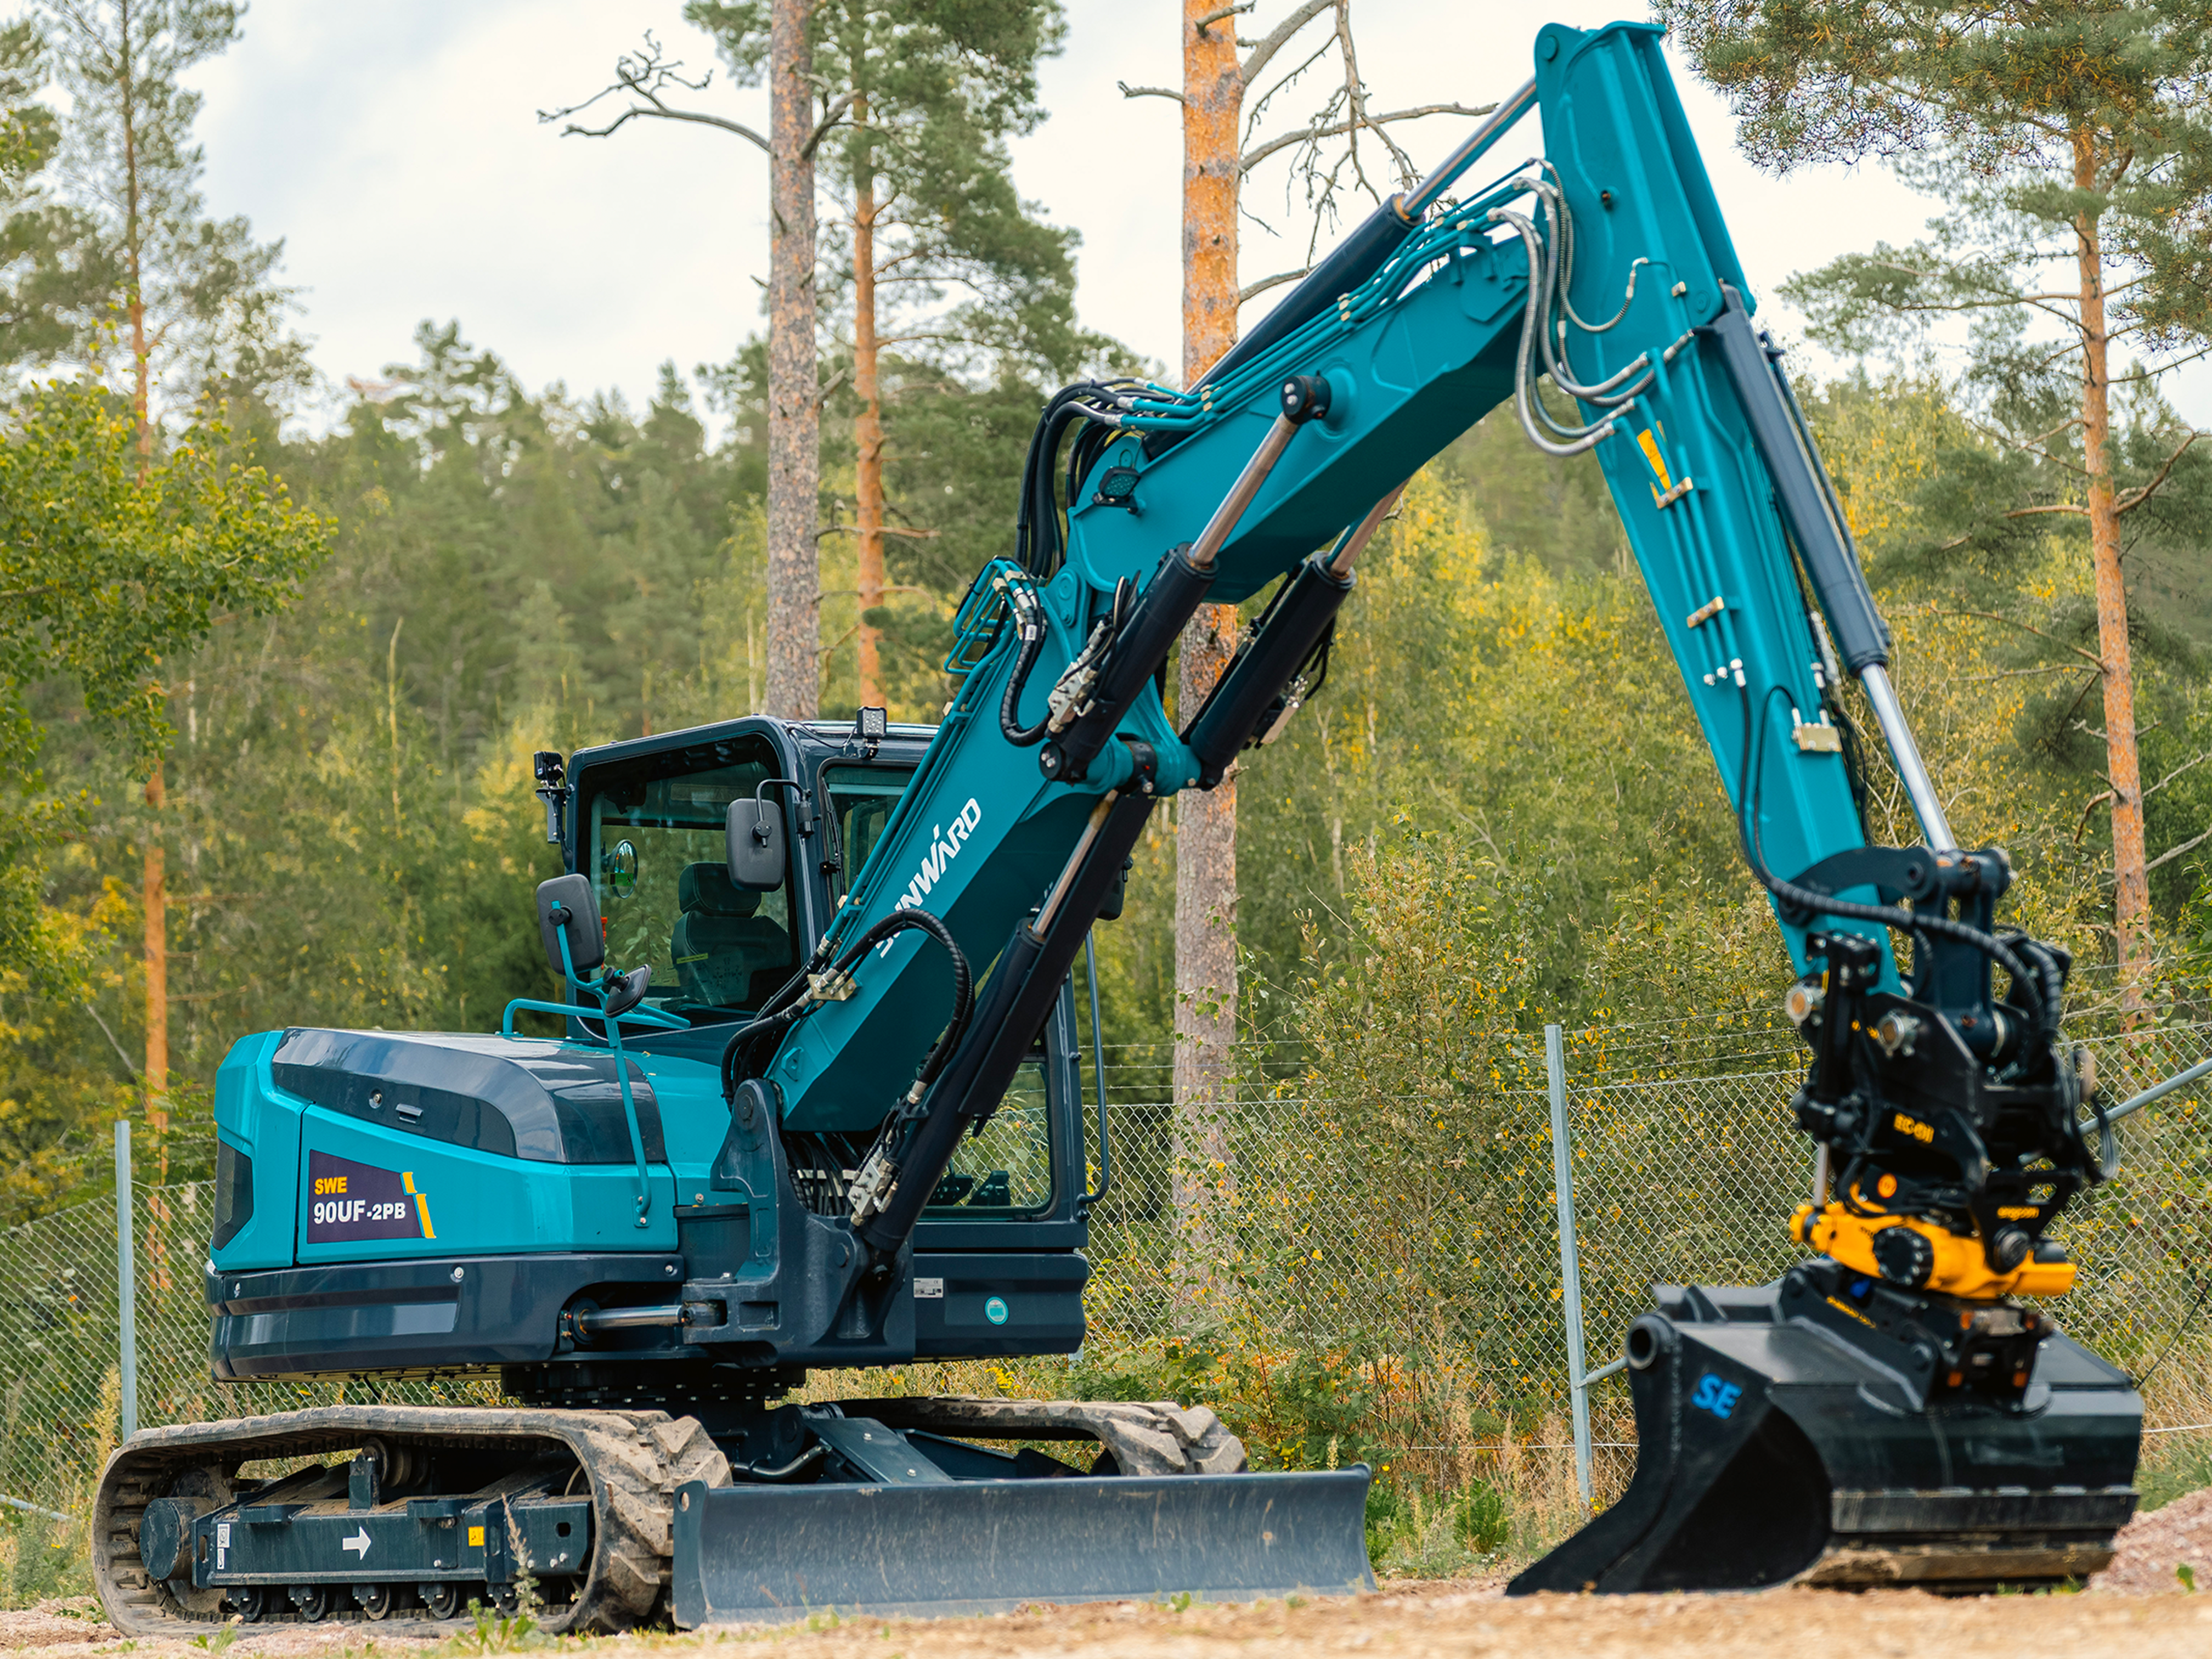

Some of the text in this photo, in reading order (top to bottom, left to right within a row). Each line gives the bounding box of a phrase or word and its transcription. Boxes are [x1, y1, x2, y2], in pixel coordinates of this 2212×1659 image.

[314, 1176, 348, 1195] SWE
[313, 1199, 406, 1224] 90UF-2PB
[1690, 1373, 1743, 1420] SE
